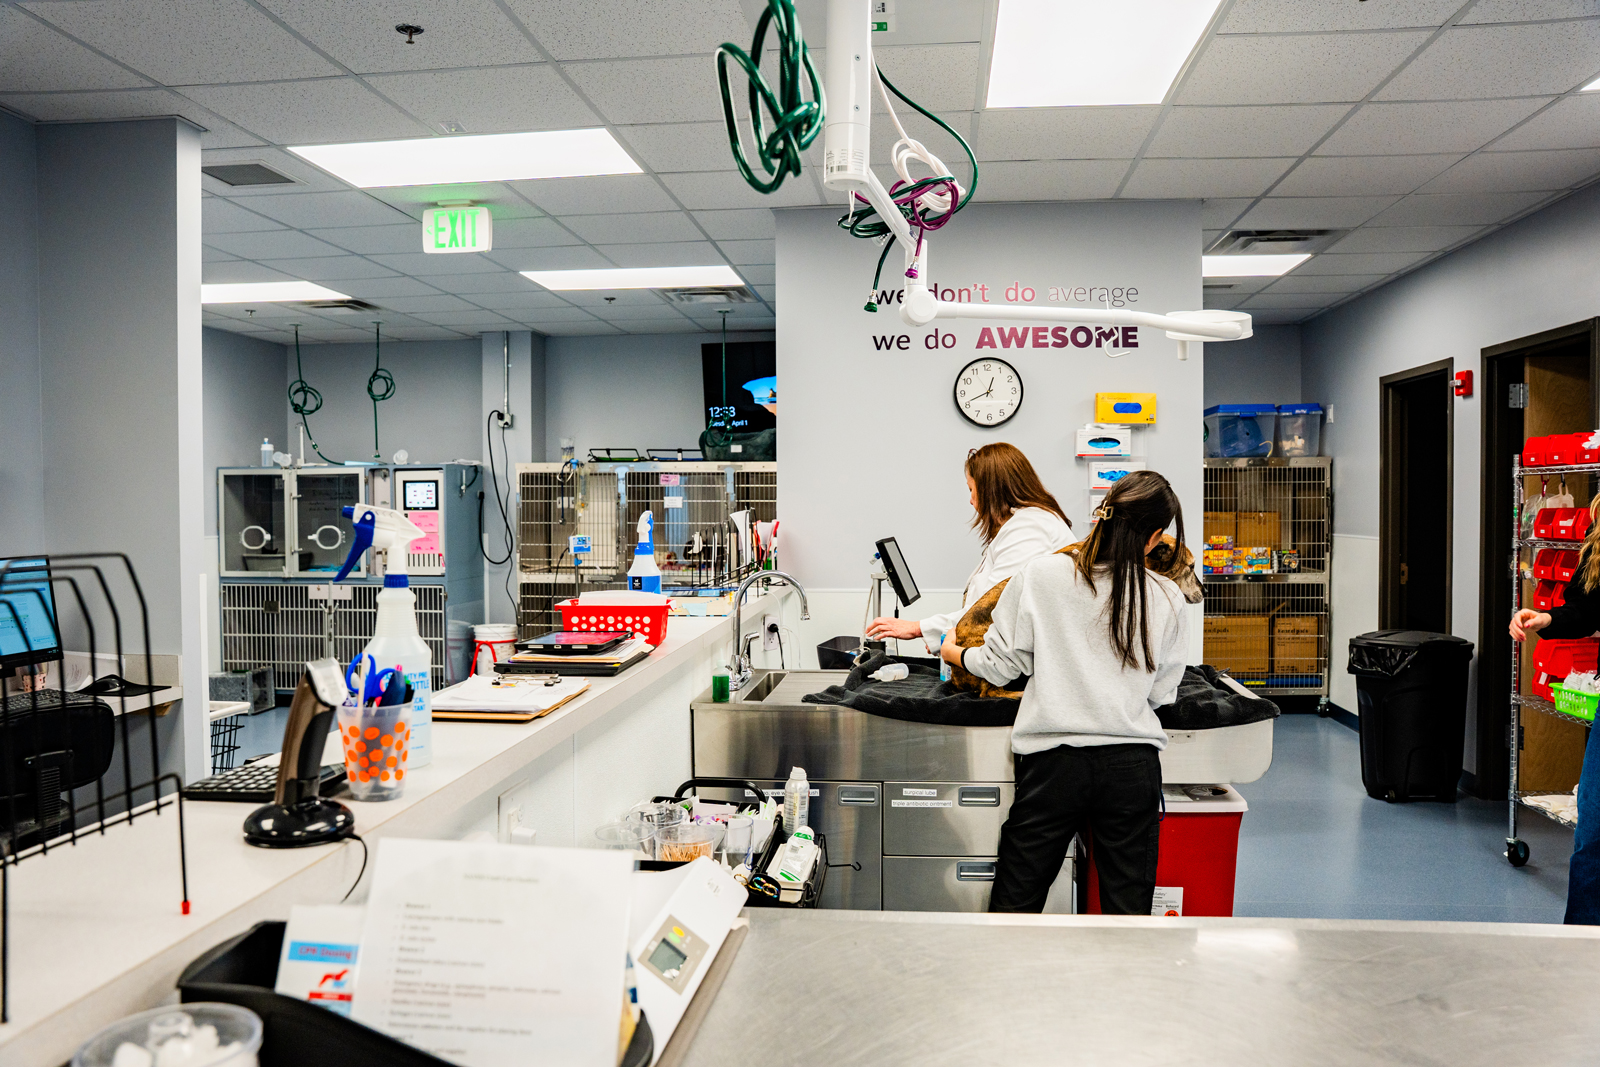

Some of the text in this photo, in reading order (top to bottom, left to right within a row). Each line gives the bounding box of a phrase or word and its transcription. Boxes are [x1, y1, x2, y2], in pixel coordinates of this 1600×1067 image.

[433, 209, 480, 249] EXIT
[876, 289, 904, 305] we
[1005, 281, 1036, 303] do
[1048, 286, 1139, 308] average
[872, 326, 1139, 351] we do AWESOME
[1007, 375, 1013, 383] 2
[964, 401, 970, 409] 8
[411, 680, 429, 690] OTTLE
